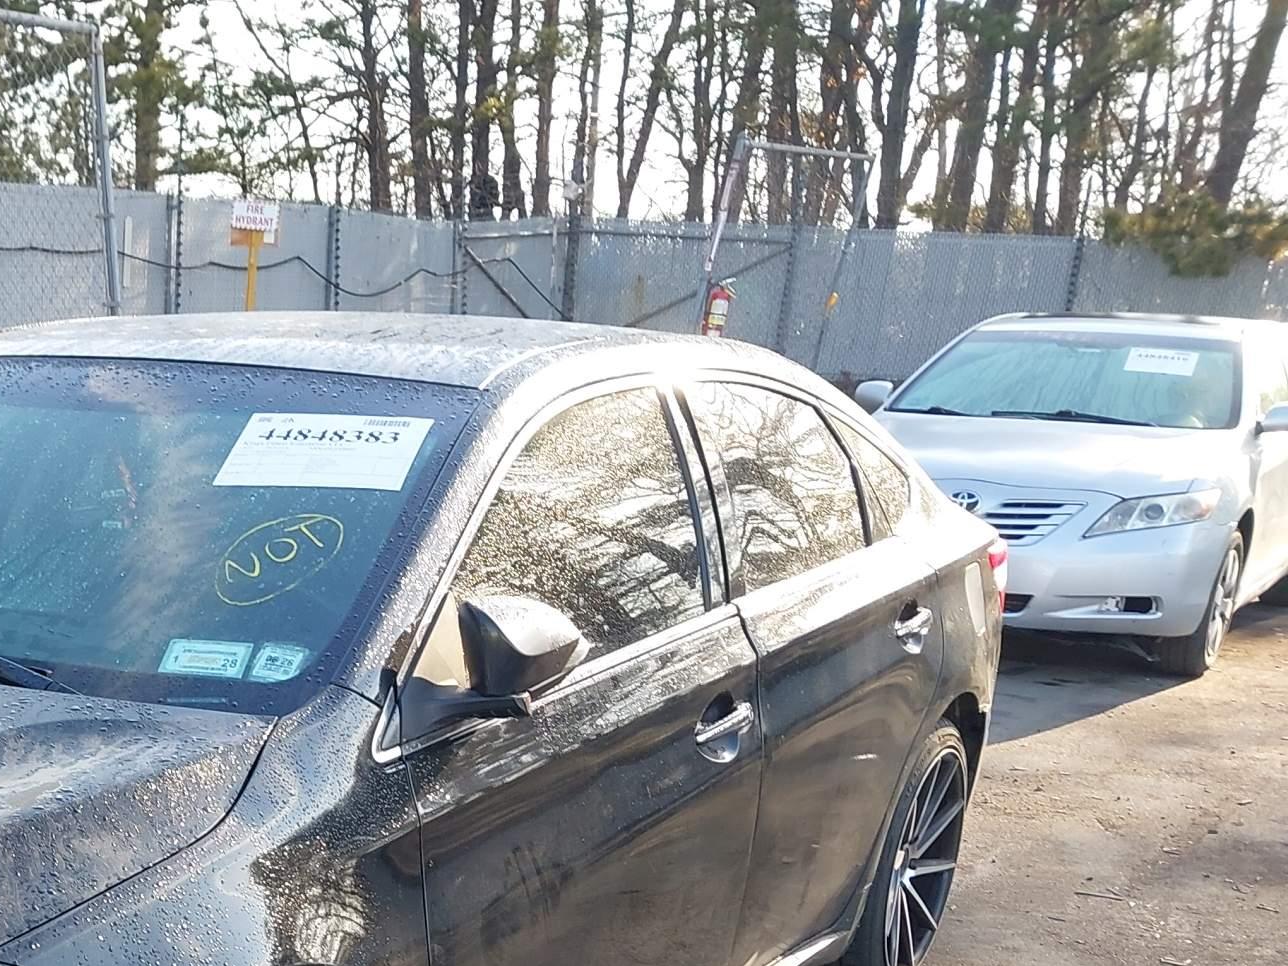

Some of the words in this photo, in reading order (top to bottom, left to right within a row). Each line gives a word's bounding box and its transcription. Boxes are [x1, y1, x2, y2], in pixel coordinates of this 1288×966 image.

[246, 205, 264, 214] FIRE
[235, 216, 274, 227] HYDRANT
[258, 428, 401, 444] 44848383
